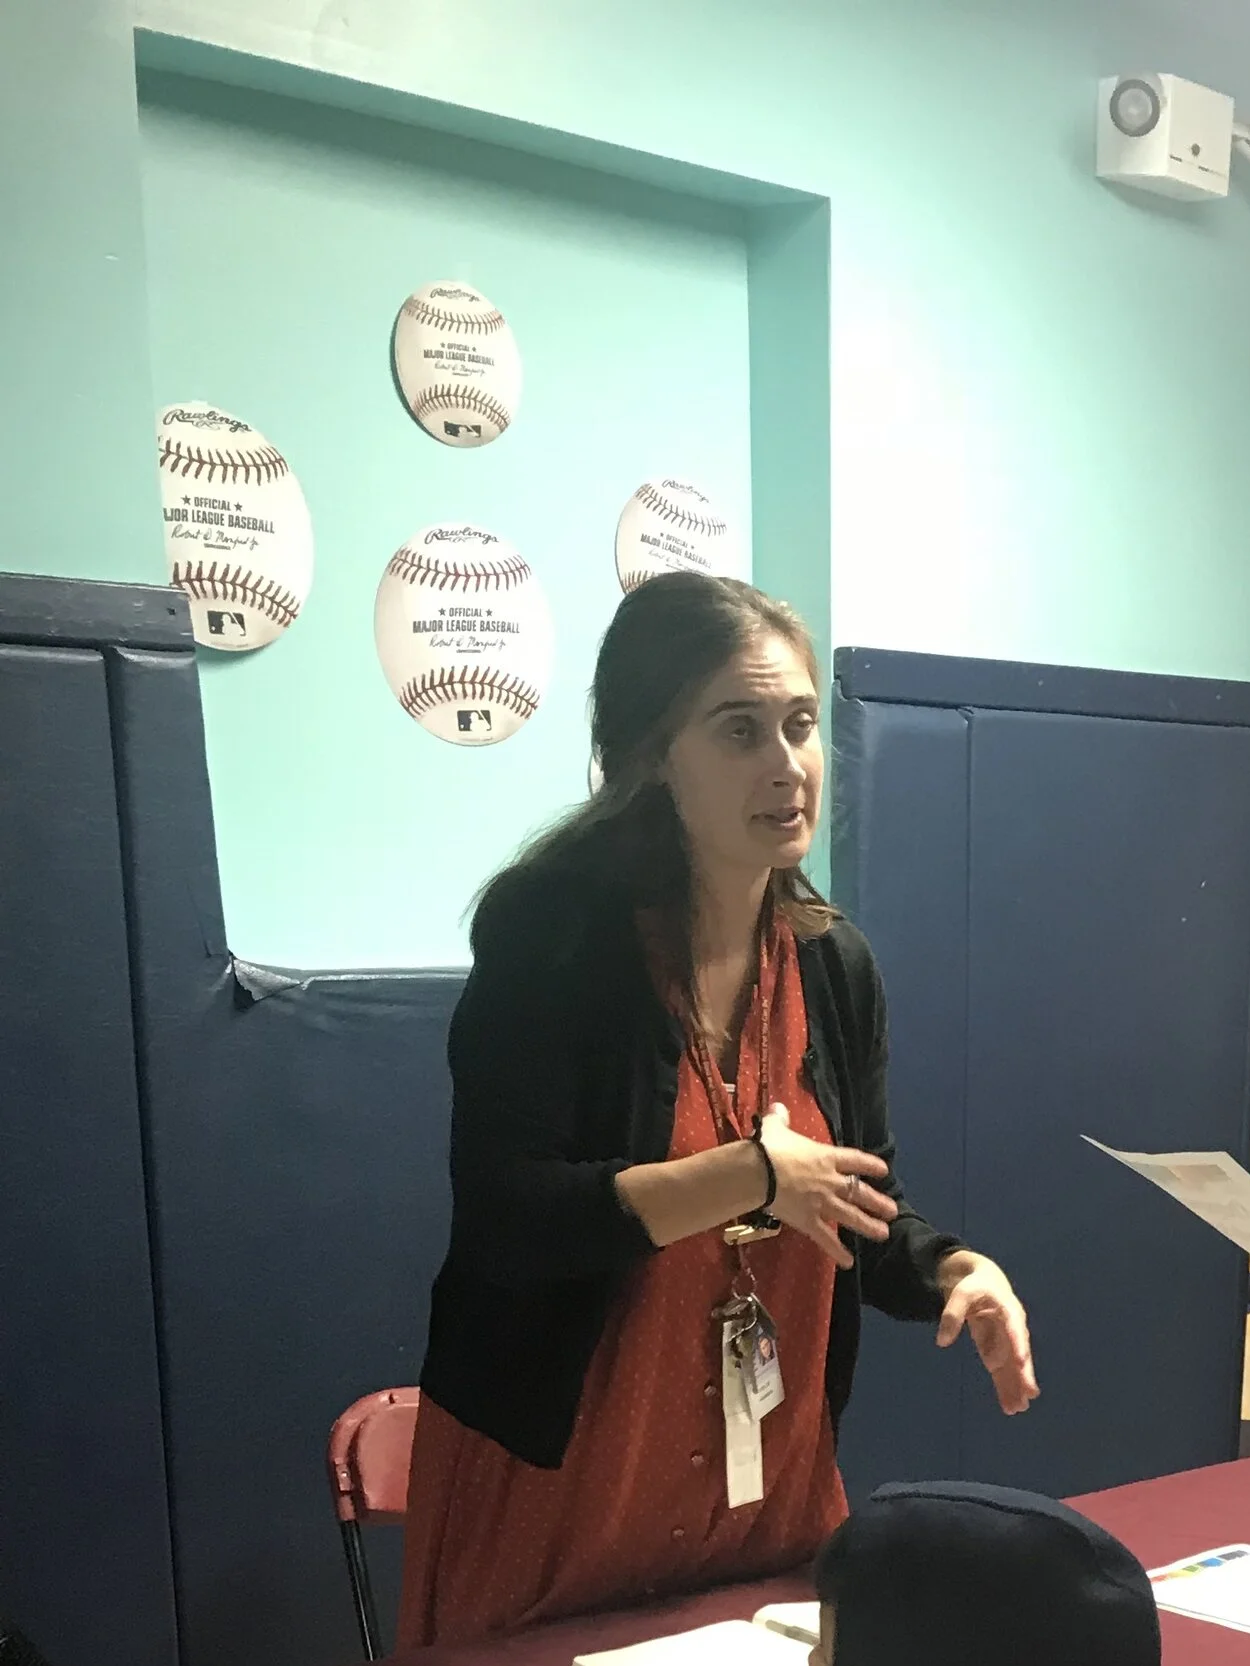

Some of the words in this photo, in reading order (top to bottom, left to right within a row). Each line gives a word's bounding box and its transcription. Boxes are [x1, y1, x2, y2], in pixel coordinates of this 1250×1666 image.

[423, 349, 444, 360] MAJOR
[445, 351, 467, 363] LEAGUE
[467, 353, 495, 367] BASEBALL
[162, 408, 252, 433] Rawlings
[194, 496, 231, 511] OFFICIAL
[163, 508, 189, 522] JOR
[191, 509, 225, 527] LEAGUE
[227, 514, 275, 534] BASEBALL
[424, 526, 499, 545] Rawlings
[449, 607, 483, 618] OFFICIAL
[413, 620, 444, 634] MAJOR
[446, 619, 477, 632] LEAGUE
[479, 620, 520, 634] BASEBALL
